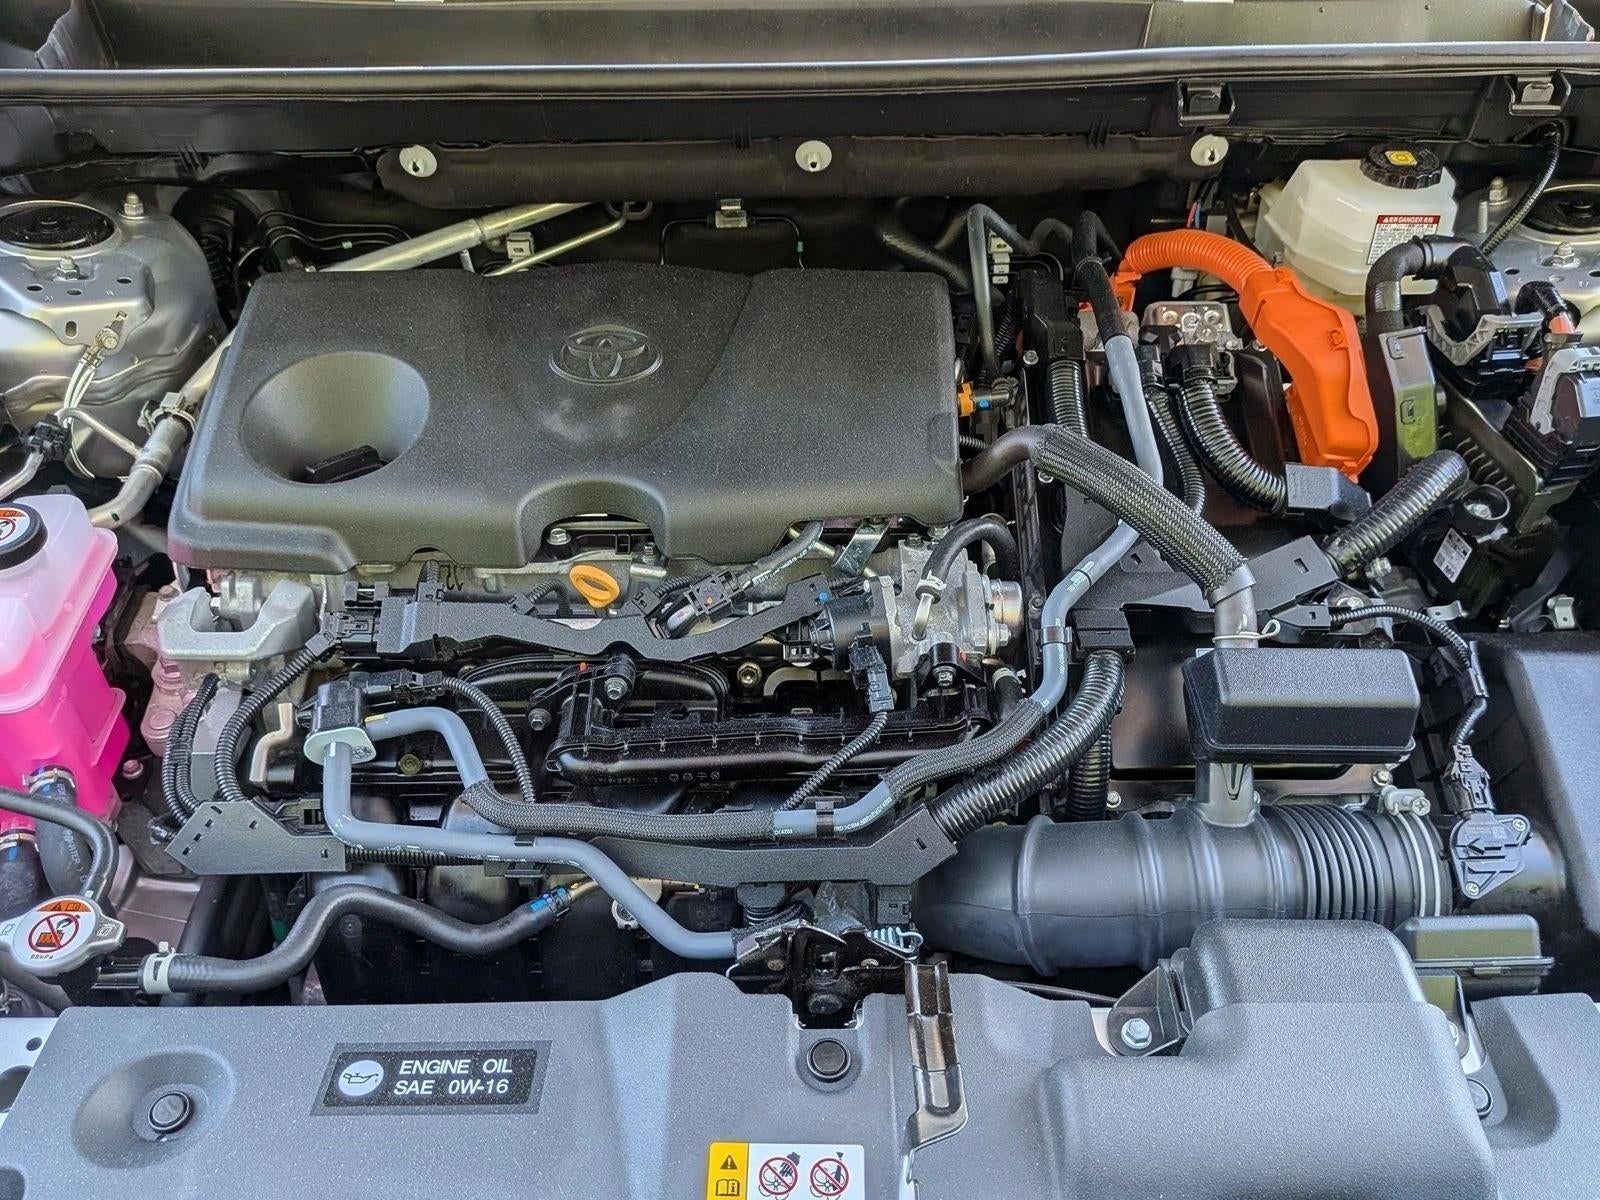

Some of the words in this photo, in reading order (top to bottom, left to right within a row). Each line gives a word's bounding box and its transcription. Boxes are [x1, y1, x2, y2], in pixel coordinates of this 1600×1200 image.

[399, 1059, 471, 1075] ENGINE
[482, 1058, 513, 1074] OIL
[394, 1079, 436, 1095] SAE
[448, 1078, 510, 1095] 0W-16
